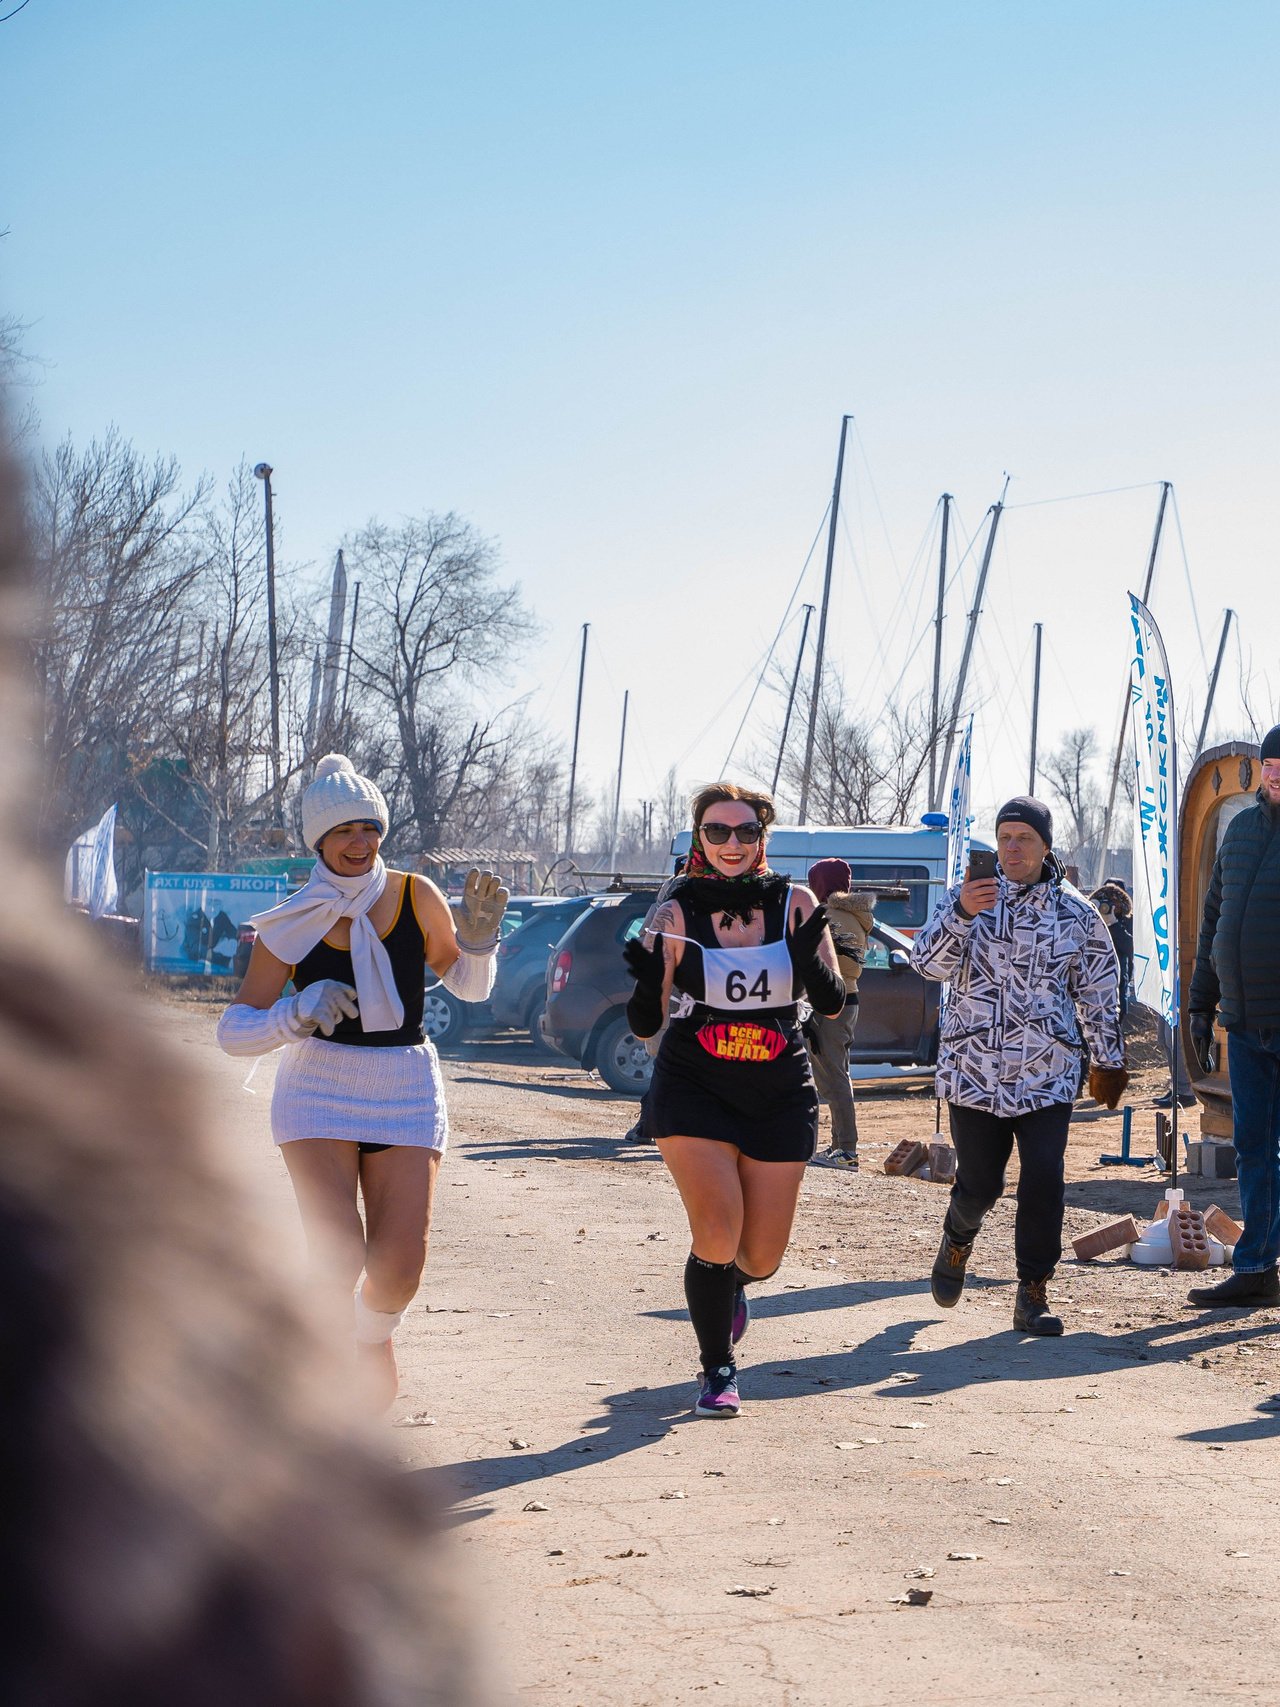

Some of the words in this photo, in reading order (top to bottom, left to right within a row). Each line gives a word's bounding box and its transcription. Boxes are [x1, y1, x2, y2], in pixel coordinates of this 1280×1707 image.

[155, 878, 180, 888] ЯХТ
[183, 879, 215, 888] КЛУБ
[229, 879, 286, 891] ЯКОРЬ
[725, 969, 771, 1003] 64
[730, 1025, 762, 1039] ВСЕМ
[716, 1039, 770, 1060] БЕГАТЬ
